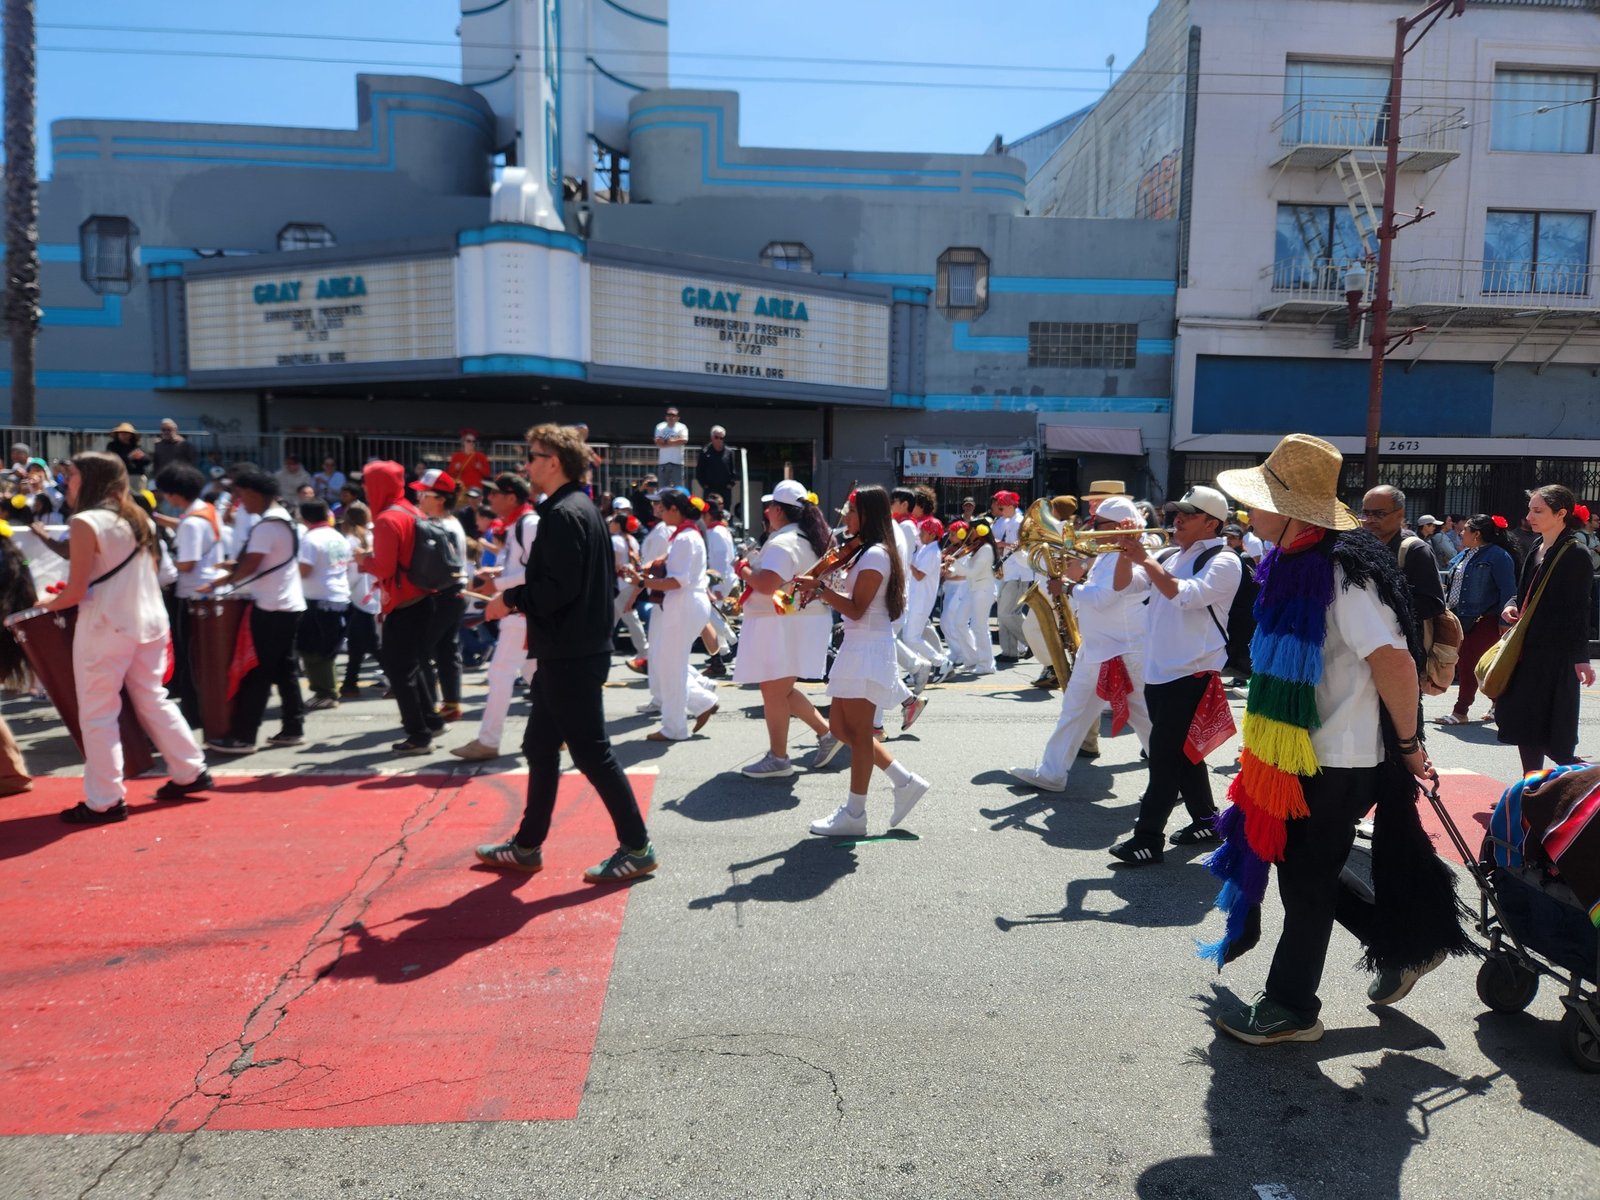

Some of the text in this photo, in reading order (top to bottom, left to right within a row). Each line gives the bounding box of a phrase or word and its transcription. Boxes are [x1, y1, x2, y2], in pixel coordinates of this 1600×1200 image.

[254, 275, 367, 304] GRAY AREA
[681, 286, 809, 322] GRAY AREA
[719, 330, 778, 347] DATA/LOSS
[736, 343, 762, 356] 5/23
[705, 362, 784, 379] GRAYAREA.ORG
[1389, 441, 1419, 451] 2673
